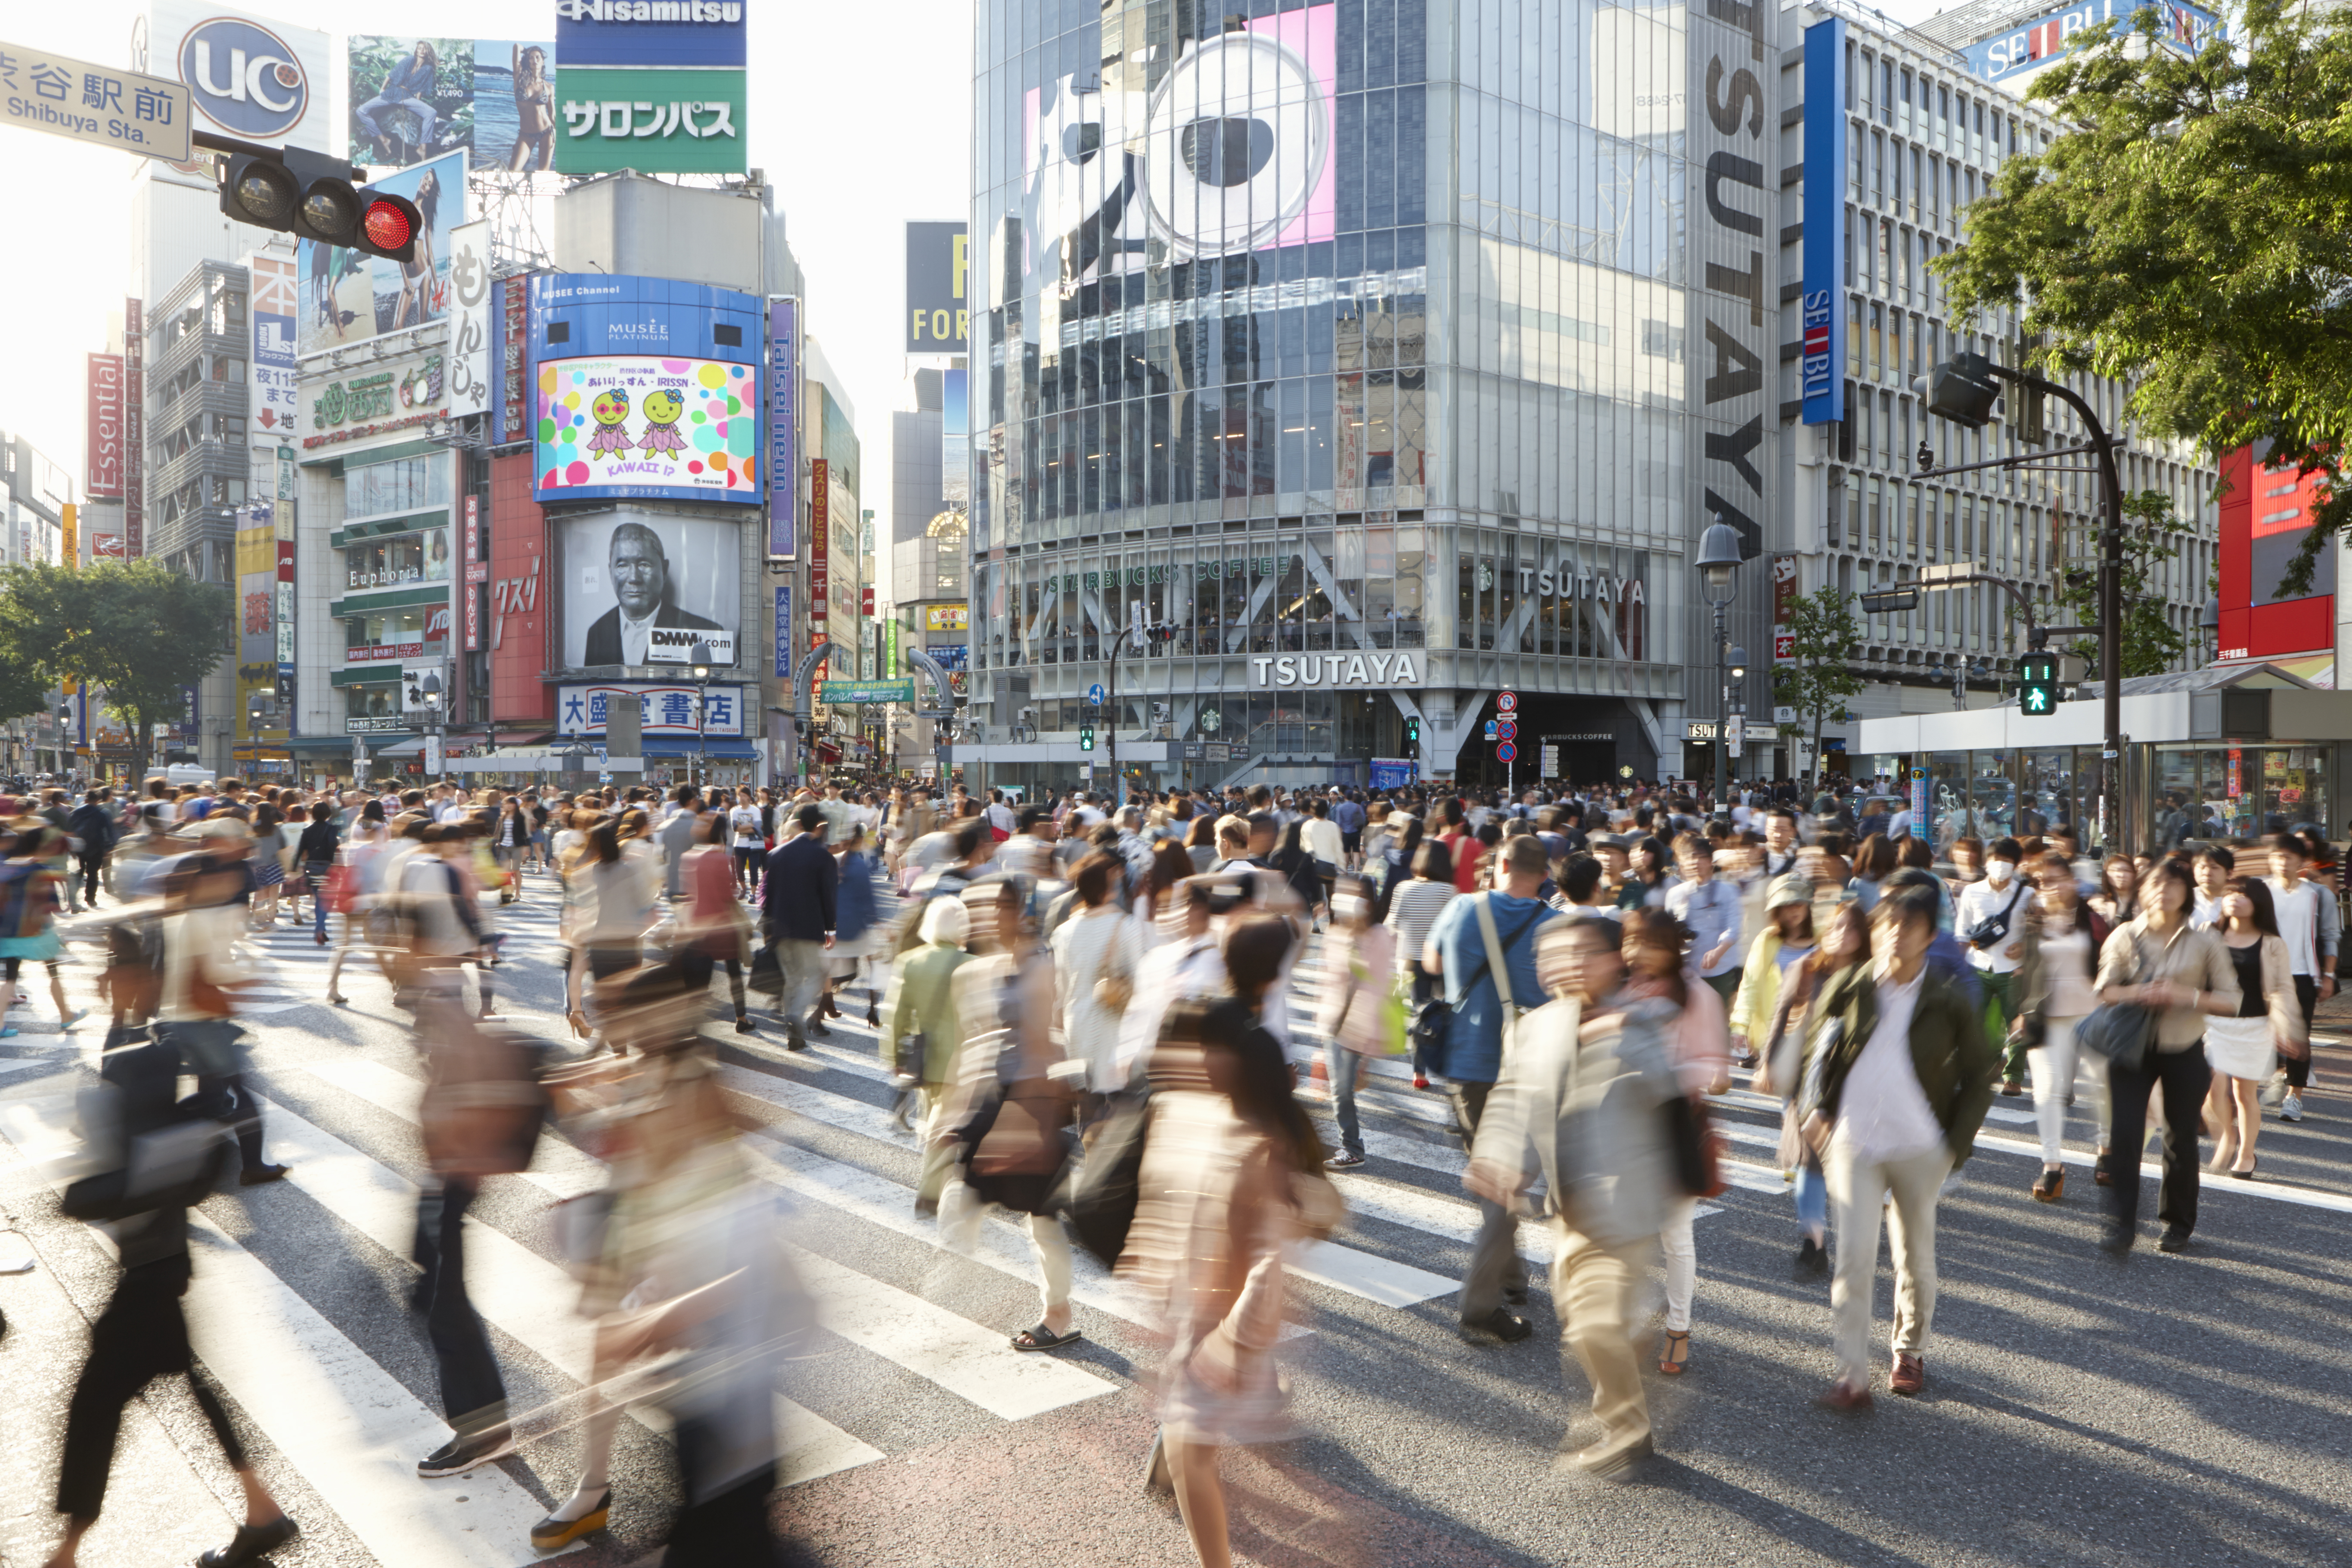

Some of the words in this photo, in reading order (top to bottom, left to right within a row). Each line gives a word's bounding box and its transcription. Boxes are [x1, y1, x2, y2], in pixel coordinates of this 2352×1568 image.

[7, 97, 98, 133] Shibuya
[108, 119, 151, 145] Sta.
[562, 100, 735, 137] サロンパス
[254, 262, 296, 316] 本
[432, 279, 450, 313] H&
[542, 288, 573, 300] MUSEE
[576, 286, 620, 295] Channel
[259, 324, 269, 350] BOOK
[453, 244, 486, 408] もんじゃ
[1804, 289, 1829, 400] SEIBU
[558, 363, 618, 373] 渋谷区PRキャラクター
[588, 377, 646, 387] あいりっすん
[658, 378, 688, 387] IRISSN
[773, 331, 791, 415] Taisei
[267, 388, 297, 405] まで
[348, 385, 394, 421] 西村
[91, 357, 116, 492] Essential
[280, 412, 297, 430] 地
[607, 462, 659, 477] KAWAII
[773, 423, 786, 492] neon
[610, 487, 669, 496] ミュゼプラチナム
[815, 464, 825, 551] クスリのことなら
[468, 500, 476, 559] お好み焼
[774, 520, 789, 528] (03)
[279, 557, 293, 565] JTB
[350, 564, 419, 588] Euphoria
[1049, 563, 1179, 593] STARBUCKS
[1192, 556, 1290, 581] COFFEE
[813, 559, 827, 613] 三千里
[1520, 567, 1645, 605] TSUTAYA
[245, 592, 271, 634] 薬
[427, 609, 449, 634] JTB
[468, 587, 476, 647] もんじゃ焼
[652, 631, 731, 649] DMMcom
[778, 593, 788, 671] 大盛堂商事ビル
[348, 649, 369, 659] 国内旅行
[373, 647, 394, 657] 海外旅行
[2219, 648, 2248, 660] 三千里薬品
[1253, 654, 1418, 686] TSUTAYA
[349, 721, 370, 729] 渋谷西村
[1874, 767, 1891, 775] SEIBU
